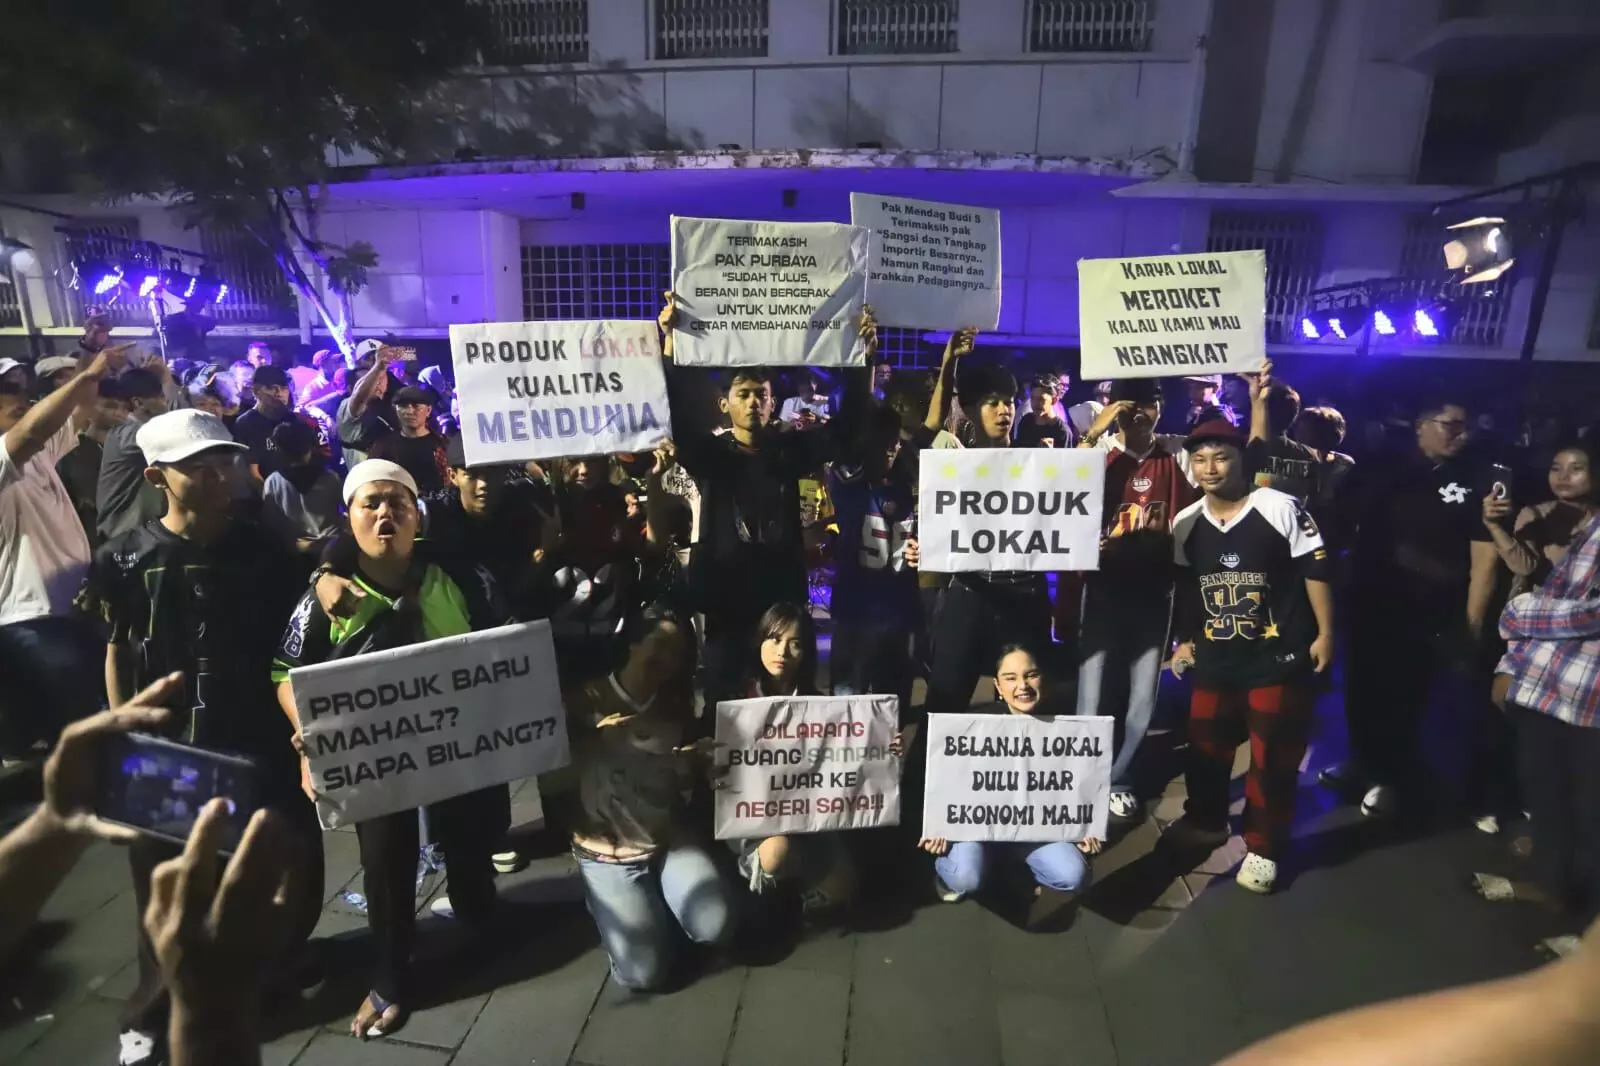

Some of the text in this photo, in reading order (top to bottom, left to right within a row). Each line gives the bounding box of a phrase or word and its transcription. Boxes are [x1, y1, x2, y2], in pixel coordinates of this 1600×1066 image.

[882, 202, 901, 213] Pak
[904, 204, 946, 221] Mendag
[949, 211, 972, 222] Budi
[891, 217, 972, 236] Terimaksih pak
[727, 236, 807, 247] TERIMAKASIH
[882, 244, 927, 256] Importir
[922, 235, 941, 245] dan
[944, 236, 987, 252] Tangkap
[715, 254, 817, 267] PAK PURBAYA
[881, 257, 985, 276] Namun Rangkul dan
[1120, 259, 1227, 280] KARYA LOKAL
[722, 272, 811, 284] "SUDAH TULUS,
[870, 272, 914, 284] arahkan
[696, 288, 738, 297] BERANI
[743, 288, 767, 297] DAN
[1120, 287, 1221, 311] MEROKET
[717, 304, 816, 315] UNTUK UMKM"
[690, 320, 841, 330] CETAR MEMBAHANA PAK!!!
[1107, 316, 1241, 334] KALAU KAMU MAU
[466, 336, 653, 364] PRODUK LOKAL
[1114, 342, 1228, 367] NGANGKAT
[507, 372, 624, 398] KUALITAS
[477, 402, 660, 444] MENDUNIA
[935, 490, 1090, 516] PRODUK
[950, 530, 1070, 554] LOKAL
[309, 656, 531, 720] PRODUK BARU
[316, 706, 460, 756] MAHAL??
[763, 722, 864, 740] DILARANG
[323, 716, 557, 791] SIAPA BILANG??
[944, 736, 1103, 757] BELANJA LOKAL
[728, 749, 801, 766] BUANG
[770, 772, 857, 791] LUAR KE
[972, 770, 1074, 792] DULU BIAR
[736, 793, 885, 818] NEGERI SAYA!!!
[946, 804, 1094, 826] EKONOMI MAJU
